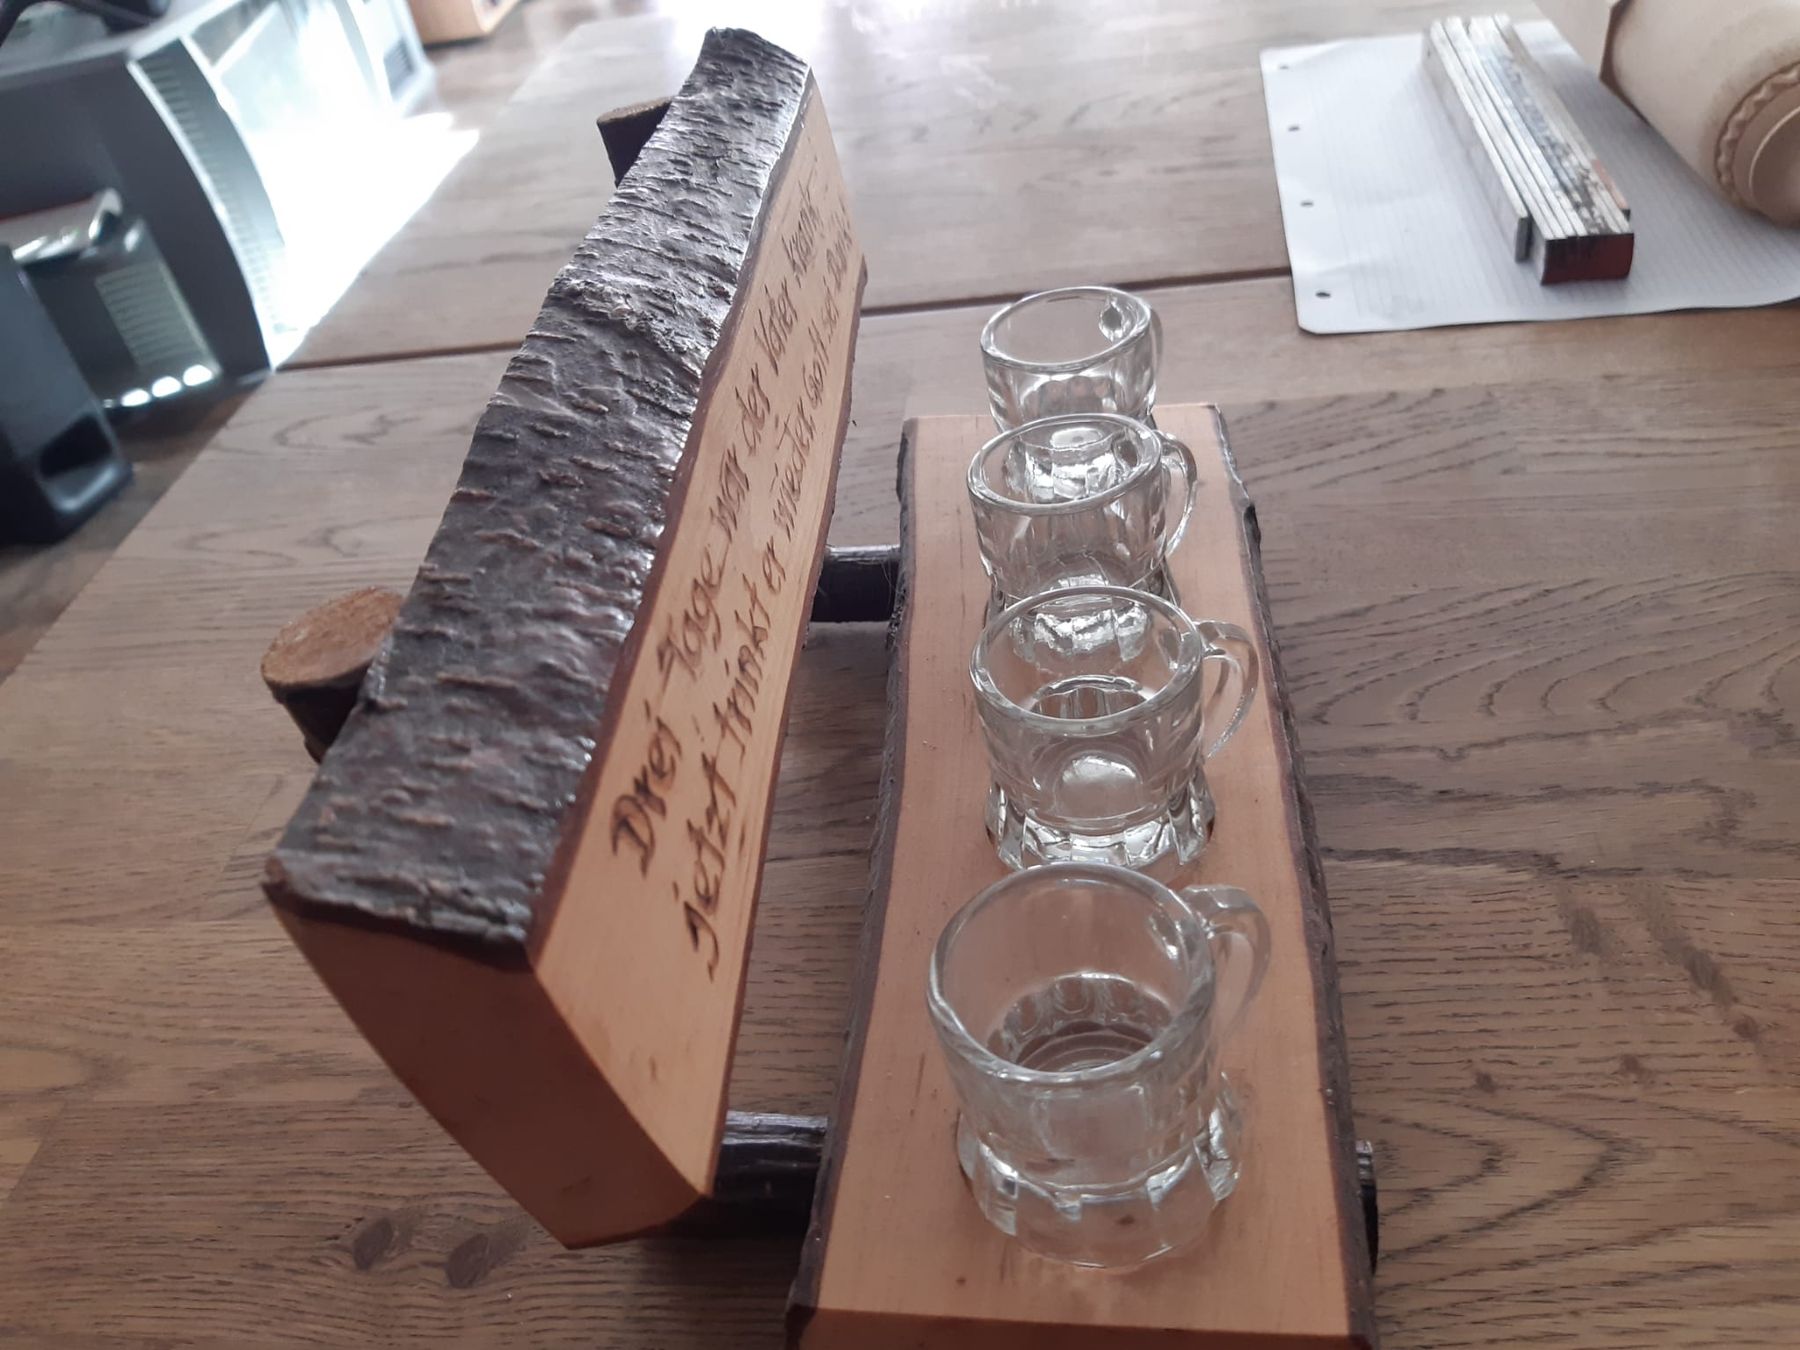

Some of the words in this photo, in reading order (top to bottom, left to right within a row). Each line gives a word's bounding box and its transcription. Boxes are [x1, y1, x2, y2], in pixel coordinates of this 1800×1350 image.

[611, 699, 682, 879] Drei
[656, 546, 724, 690] Tage
[709, 443, 750, 544] war
[735, 362, 771, 456] der
[753, 276, 798, 377] Vater
[673, 750, 737, 983] jetzt
[712, 572, 772, 761] trinkt
[761, 535, 786, 595] er
